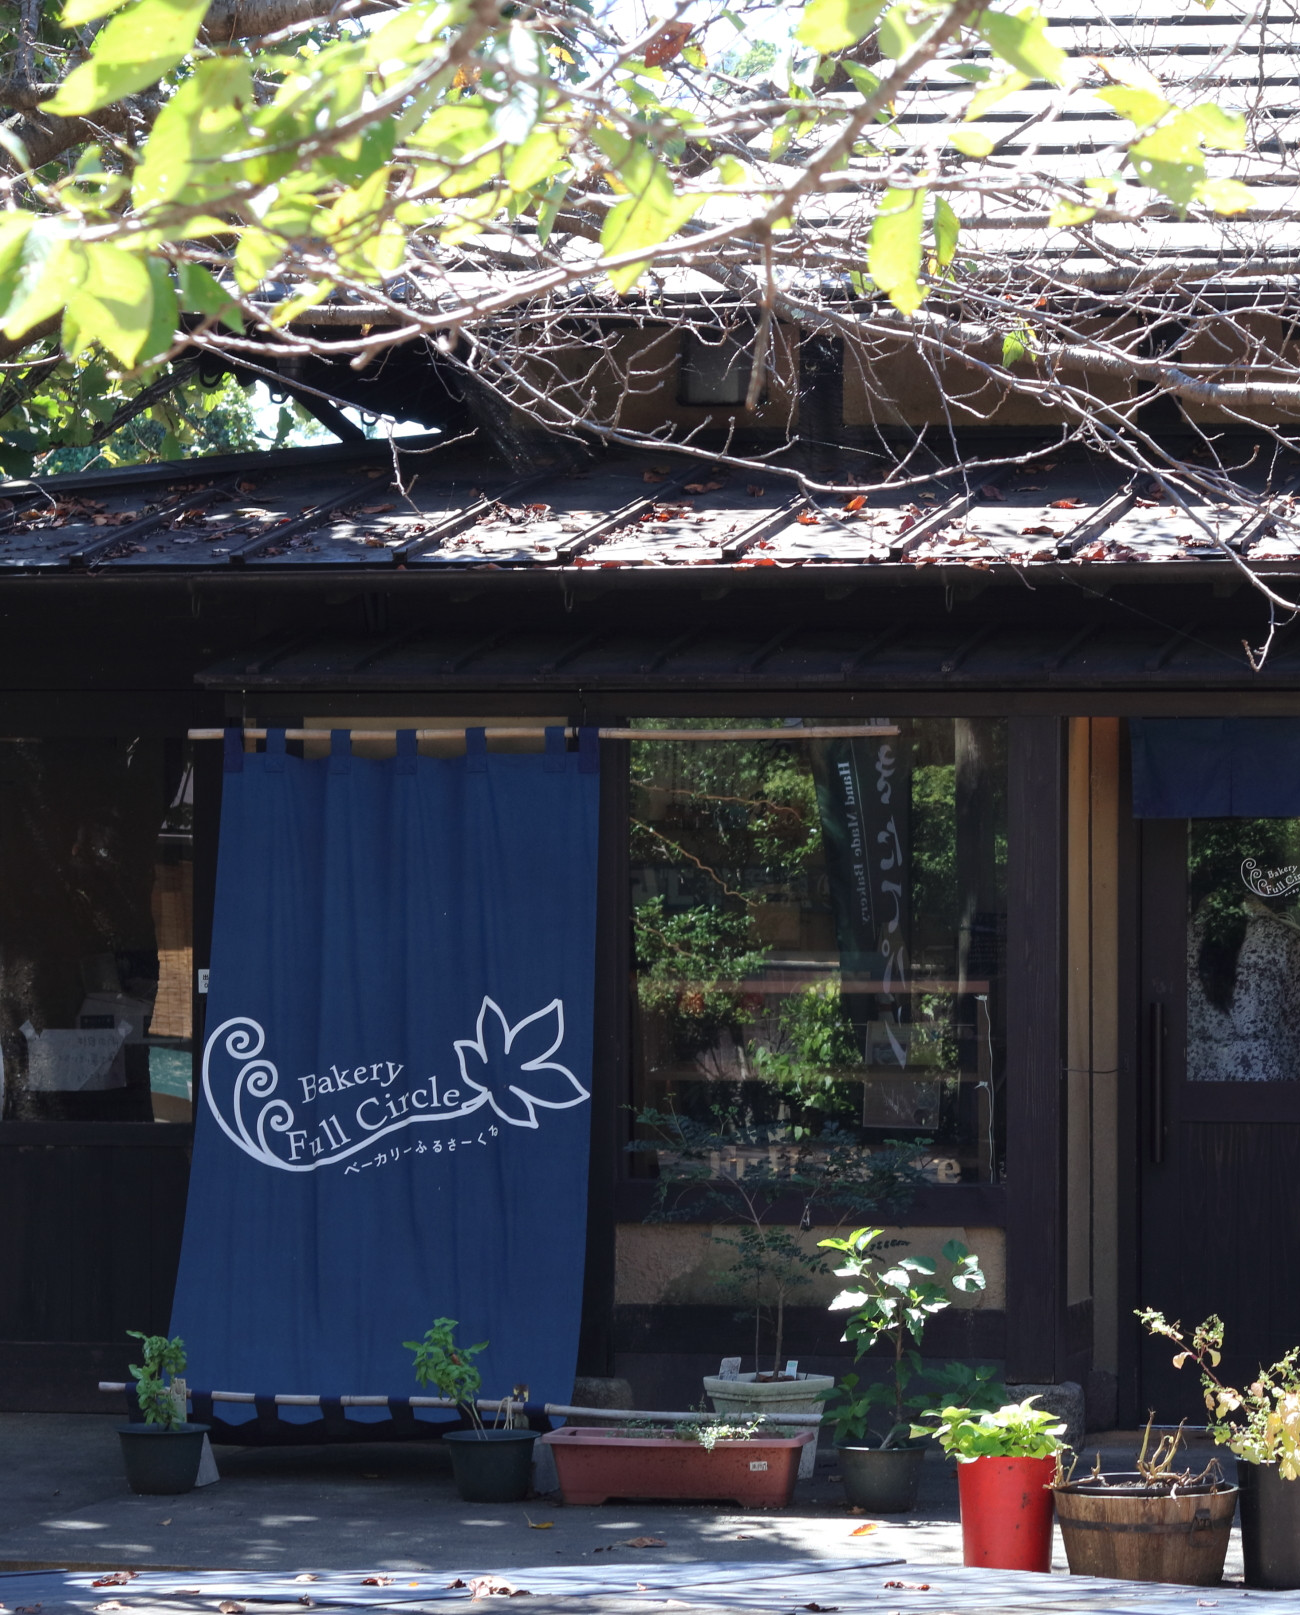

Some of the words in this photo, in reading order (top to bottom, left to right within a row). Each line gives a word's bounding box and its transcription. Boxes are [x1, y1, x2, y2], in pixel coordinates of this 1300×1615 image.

[1266, 881, 1285, 894] Full
[1267, 865, 1298, 879] Bakery
[298, 1060, 404, 1104] Bakery
[286, 1114, 352, 1161] Full
[356, 1076, 461, 1131] Circle
[344, 1125, 499, 1176] ベーカリーふるさーくる
